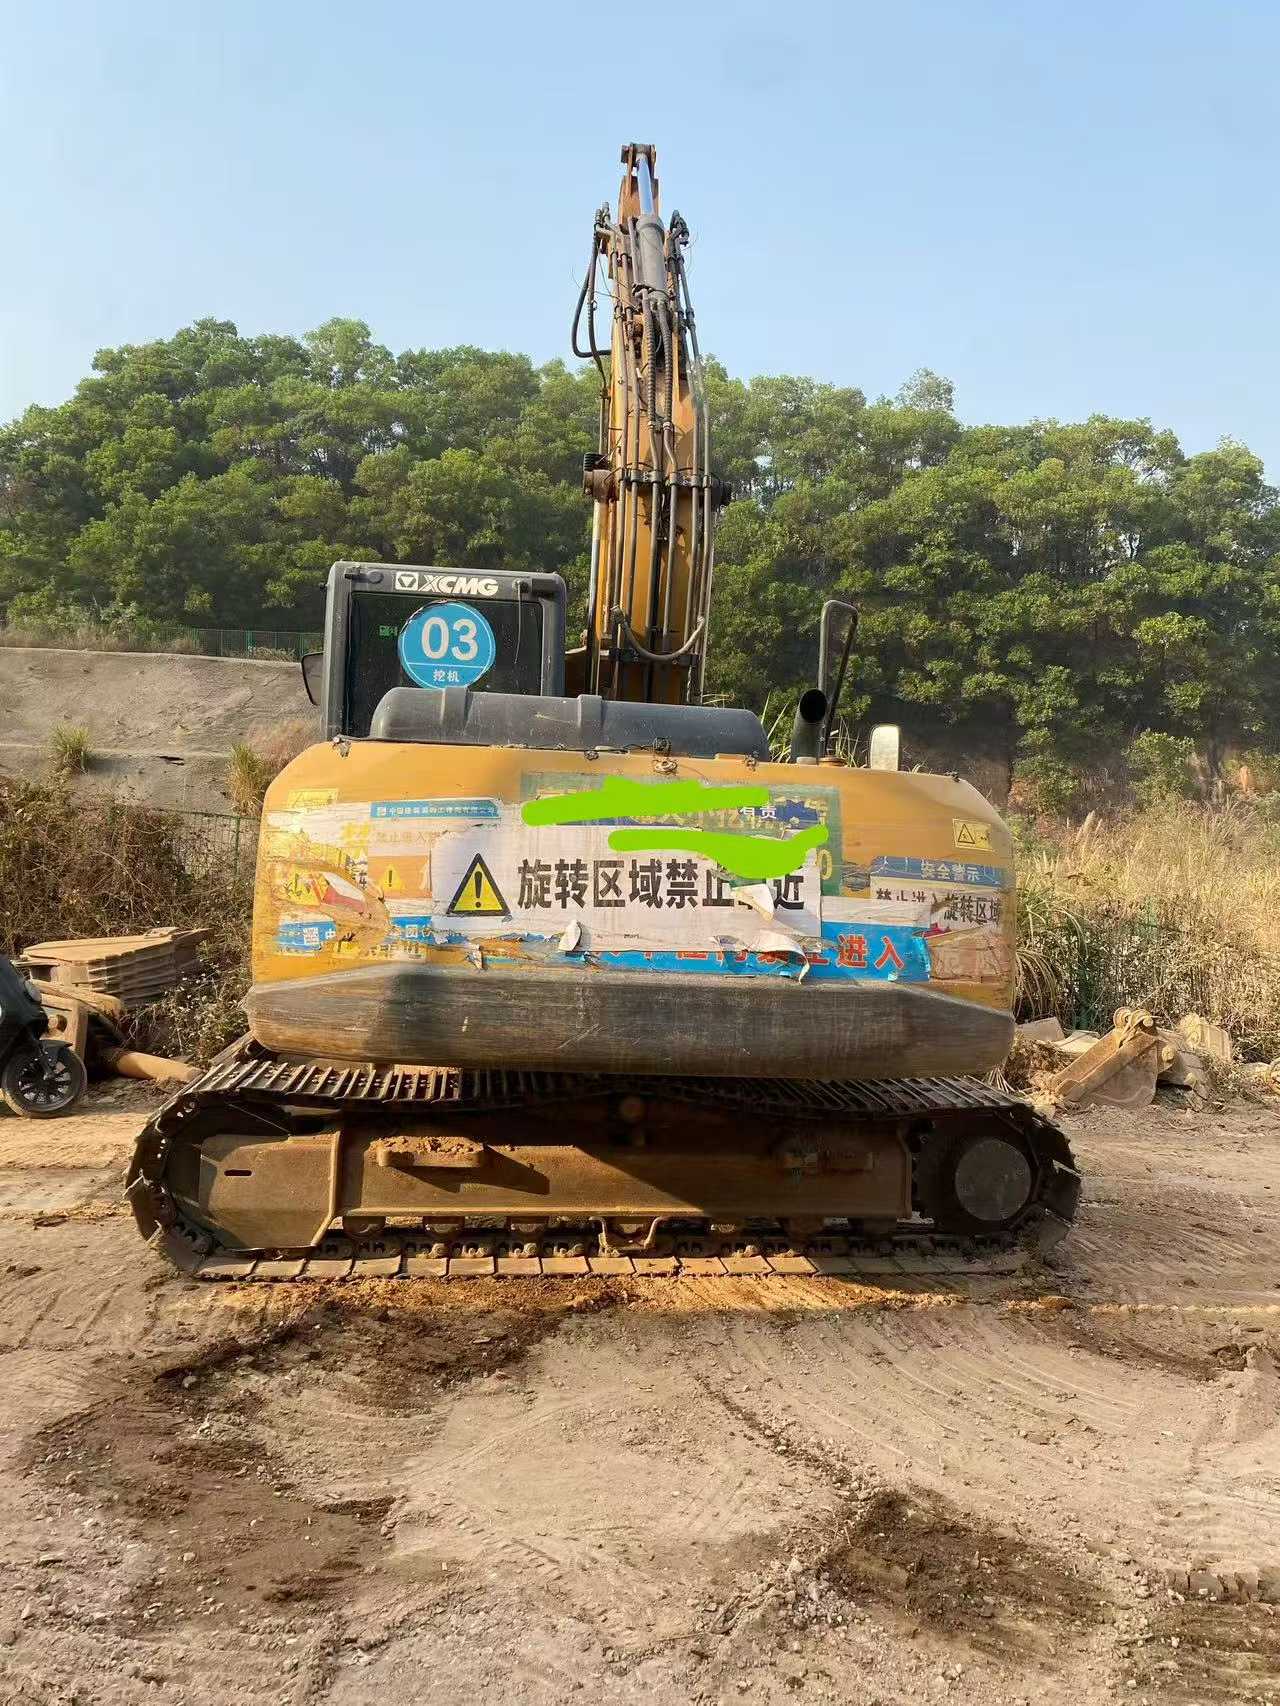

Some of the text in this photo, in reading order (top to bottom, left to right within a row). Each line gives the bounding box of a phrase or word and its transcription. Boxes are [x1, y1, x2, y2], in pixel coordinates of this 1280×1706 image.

[418, 574, 499, 596] XCMG
[421, 617, 479, 661] 03
[432, 670, 460, 683] 挖机
[517, 858, 805, 910] 旋转区域禁止近
